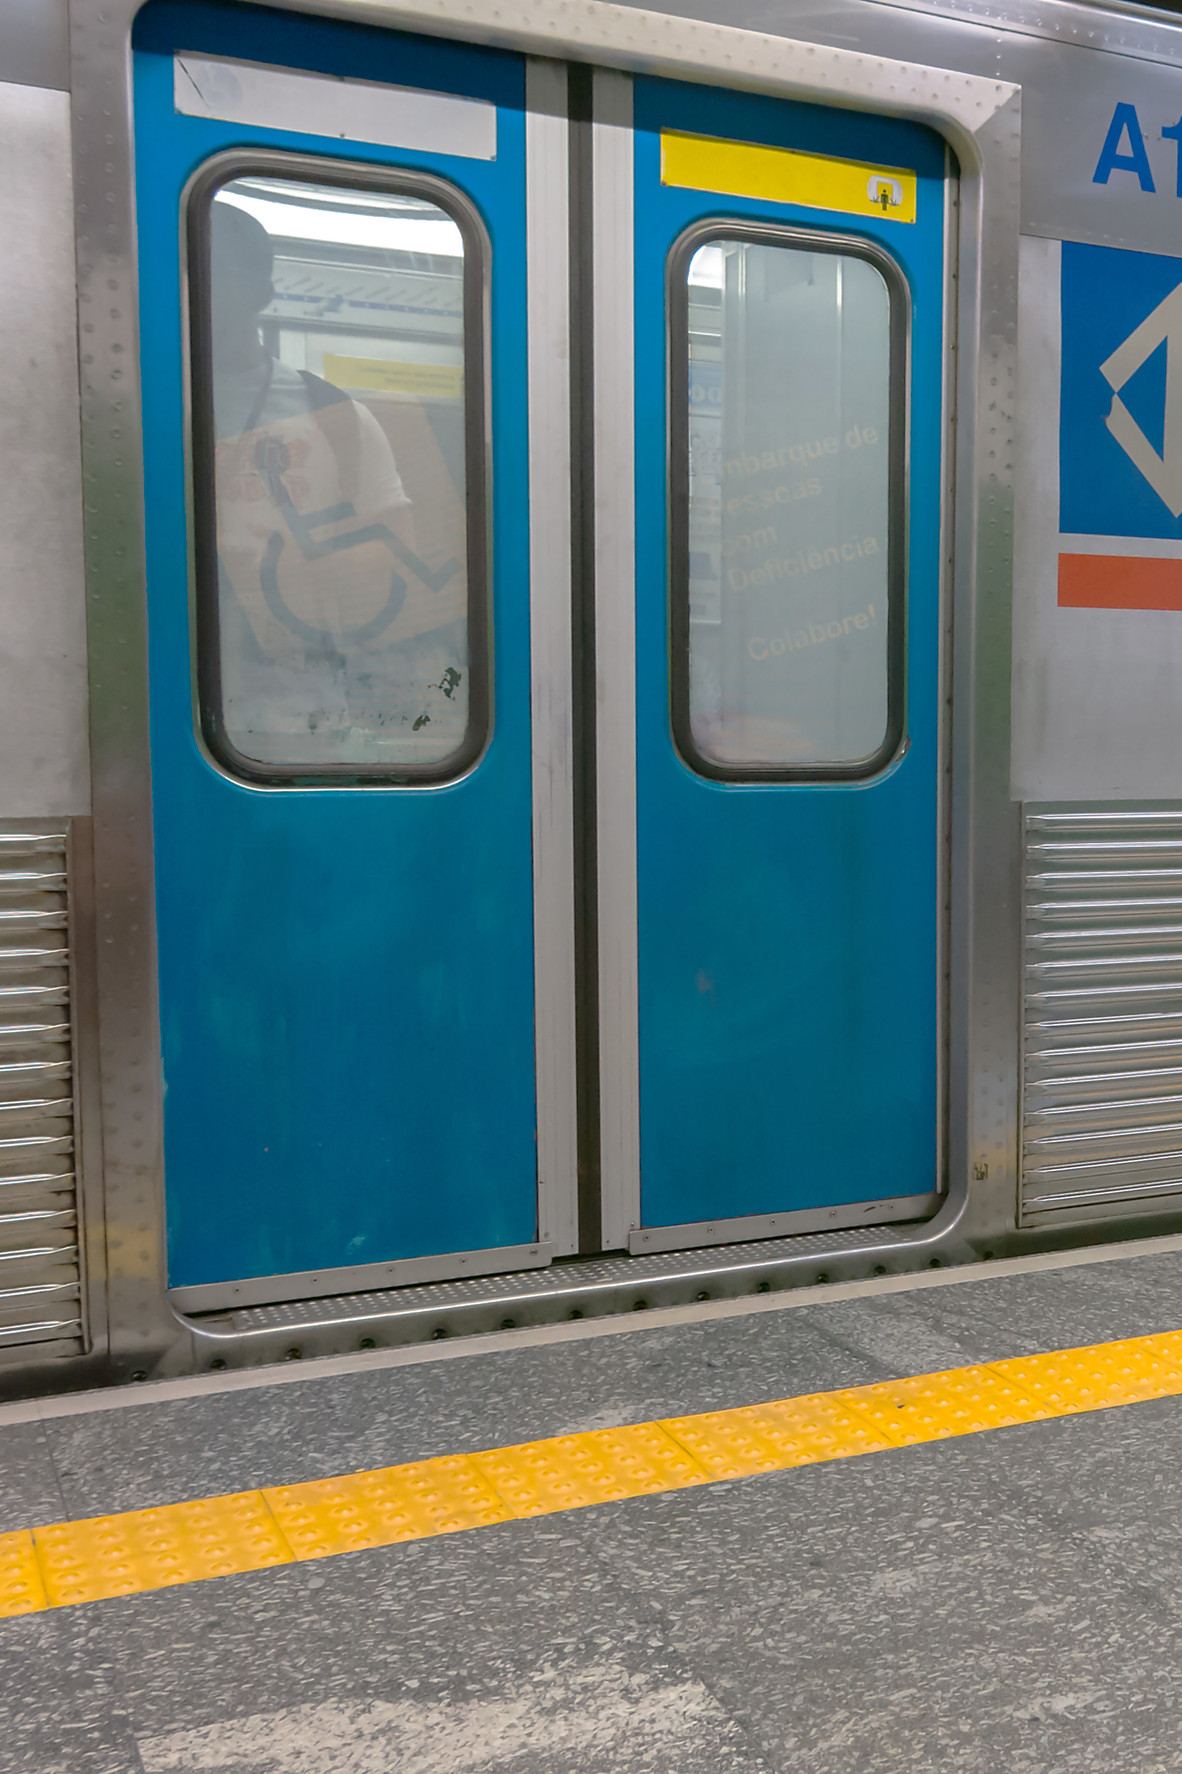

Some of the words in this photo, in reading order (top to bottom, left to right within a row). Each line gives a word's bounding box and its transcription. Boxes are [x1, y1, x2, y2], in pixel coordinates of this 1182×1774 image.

[702, 436, 839, 484] mbarque
[845, 424, 879, 449] de
[748, 603, 876, 661] Colabore!
